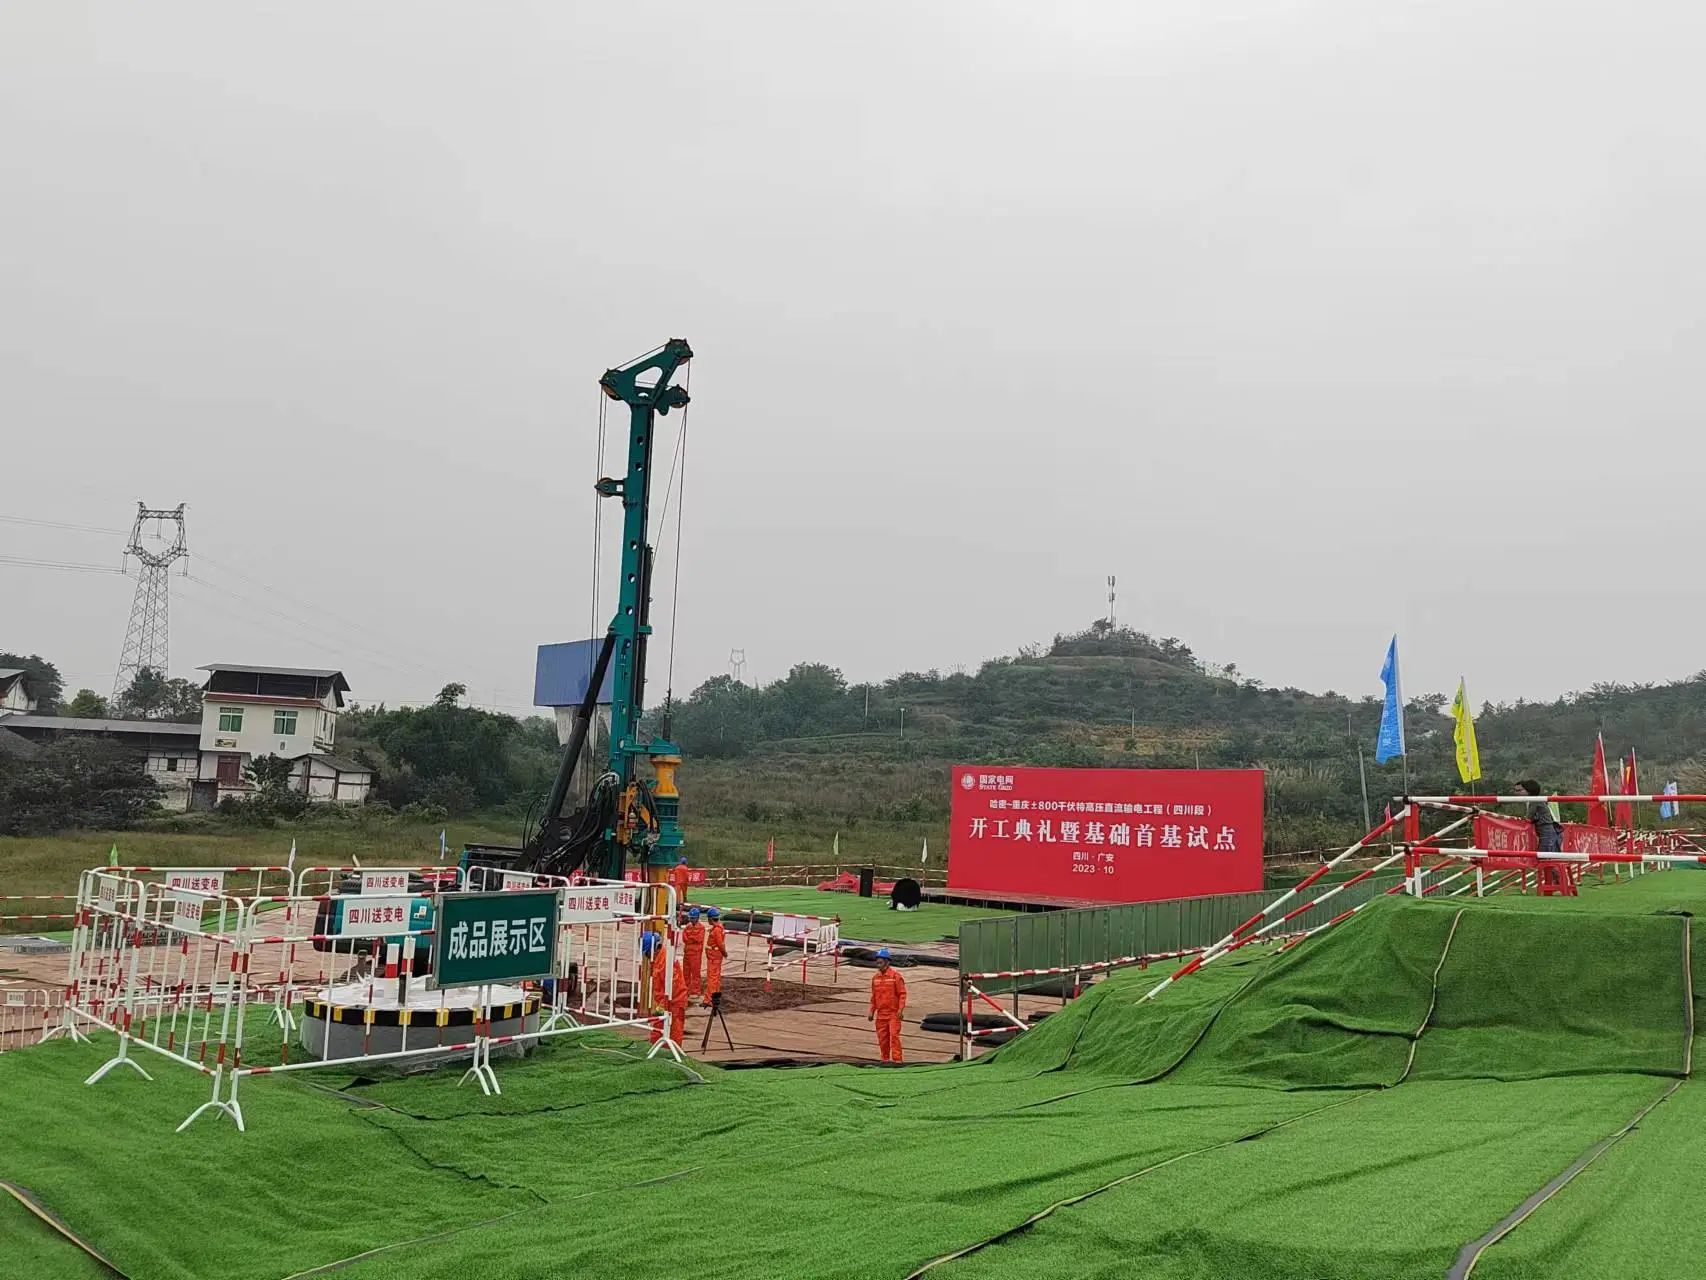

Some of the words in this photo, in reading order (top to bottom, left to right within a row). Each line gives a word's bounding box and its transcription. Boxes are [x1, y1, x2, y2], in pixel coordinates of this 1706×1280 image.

[979, 775, 1013, 785] 国家电网
[969, 817, 1236, 850] 开工典礼暨基础首基试点
[172, 877, 219, 890] 四川送变电
[365, 876, 405, 888] 四川送变电
[568, 896, 609, 910] 四川送变电
[348, 906, 404, 924] 四川送变电
[448, 917, 546, 960] 成品展示区
